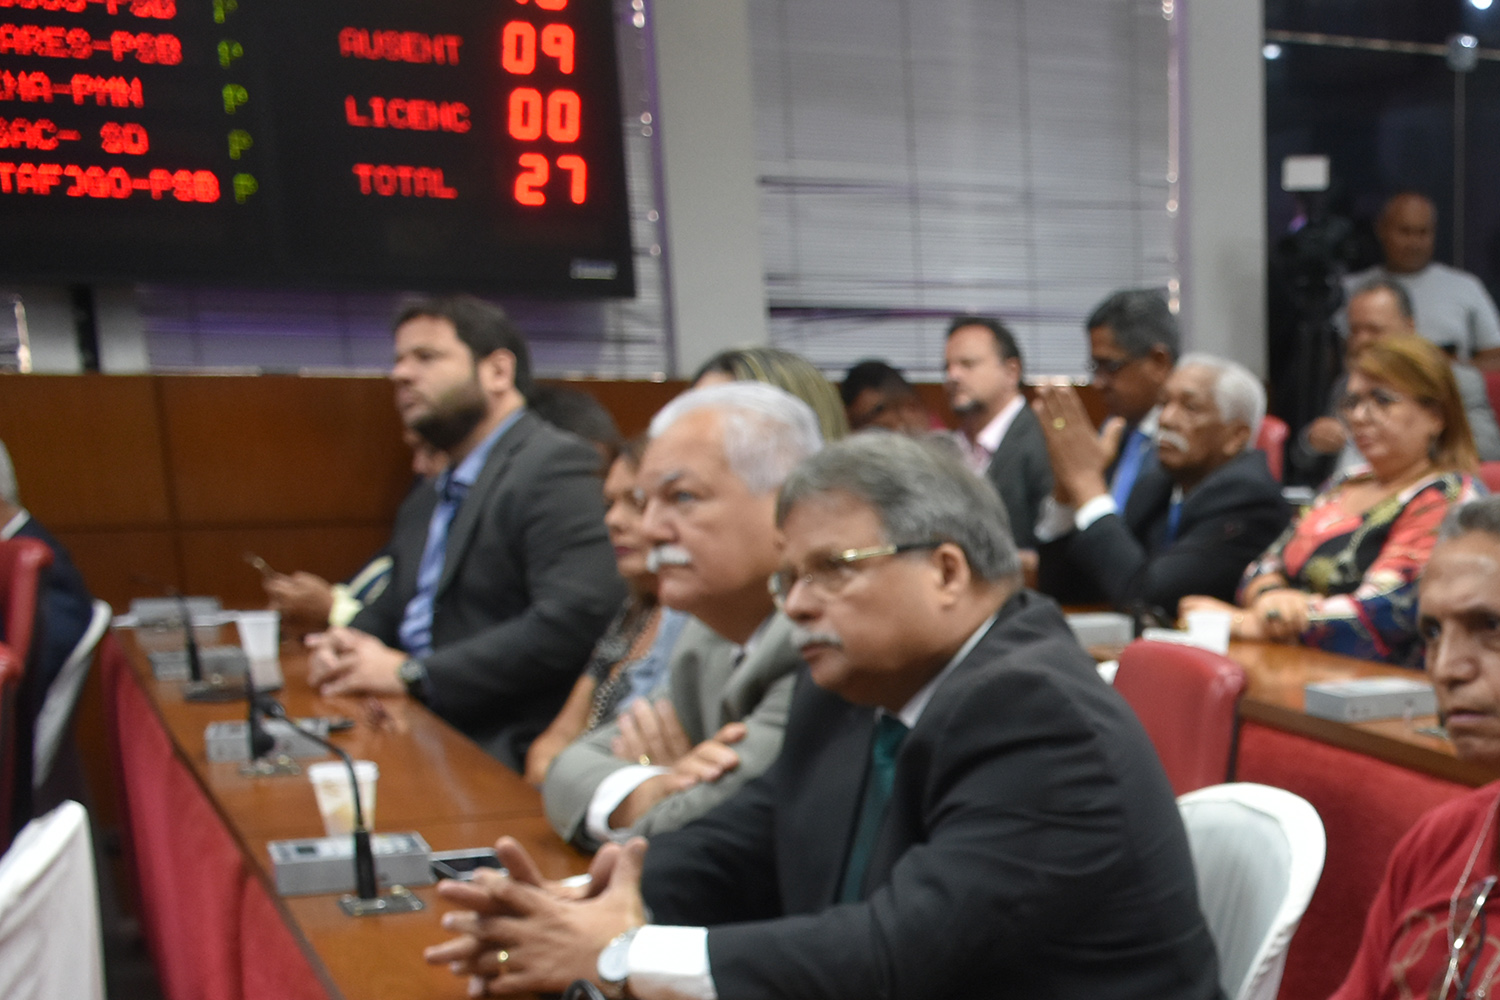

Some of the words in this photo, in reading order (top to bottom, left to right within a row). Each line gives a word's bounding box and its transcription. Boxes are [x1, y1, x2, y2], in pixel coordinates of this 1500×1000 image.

[502, 20, 575, 75] 09
[345, 95, 472, 133] LICENC
[509, 87, 581, 142] 00
[352, 163, 458, 199] TOTAL
[514, 153, 587, 206] 27
